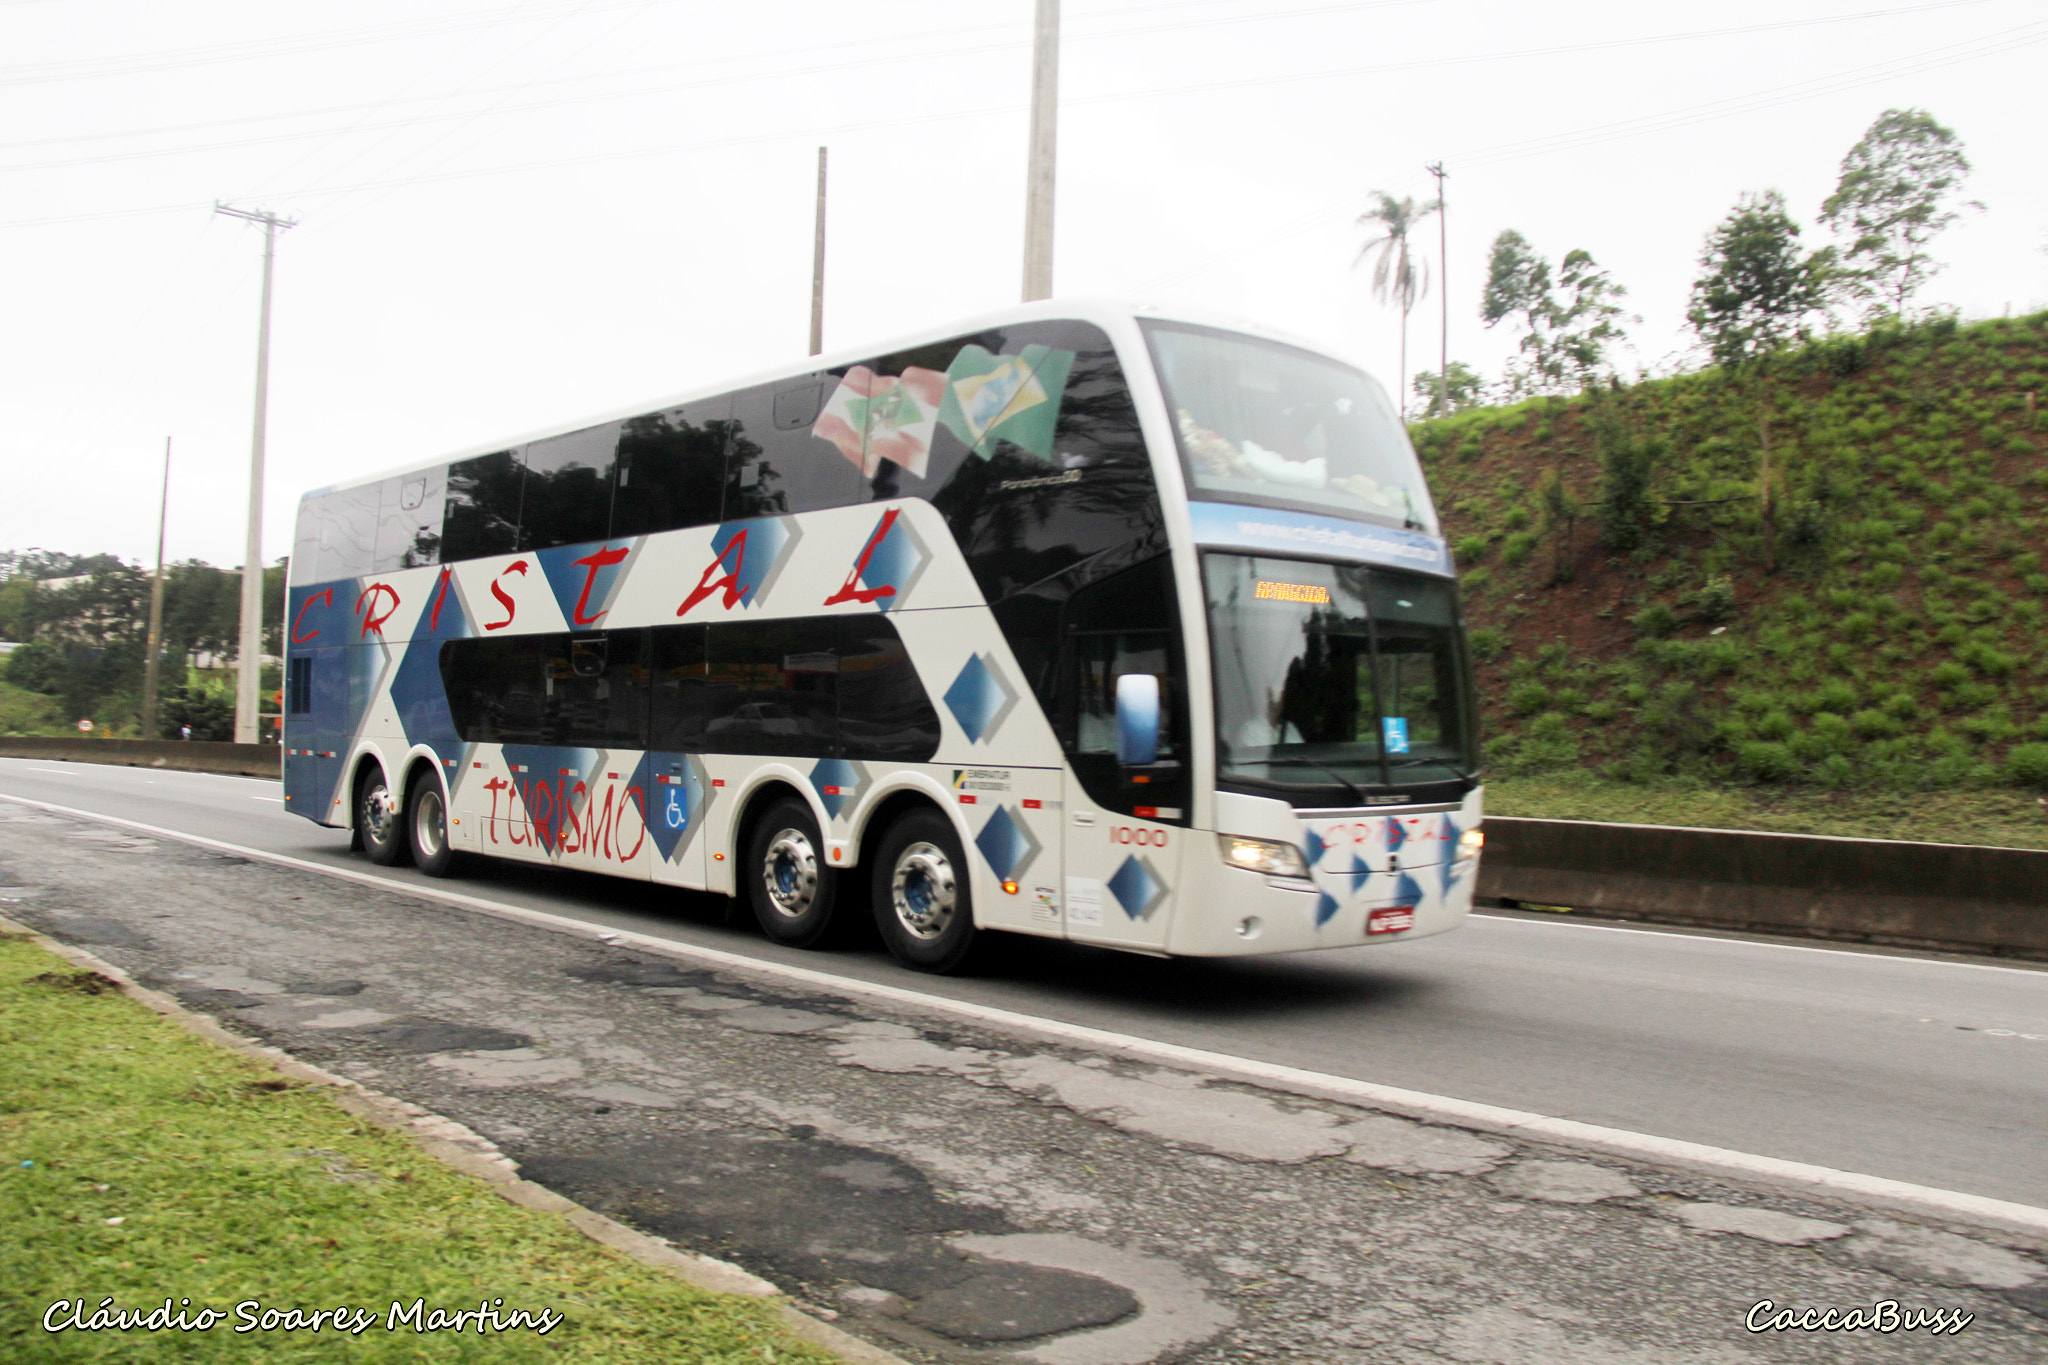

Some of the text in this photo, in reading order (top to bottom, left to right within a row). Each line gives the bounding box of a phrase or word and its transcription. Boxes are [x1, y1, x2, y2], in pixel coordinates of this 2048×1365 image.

[292, 508, 900, 643] CRISTAL
[483, 776, 645, 863] TURISMO
[1109, 826, 1168, 848] 1000
